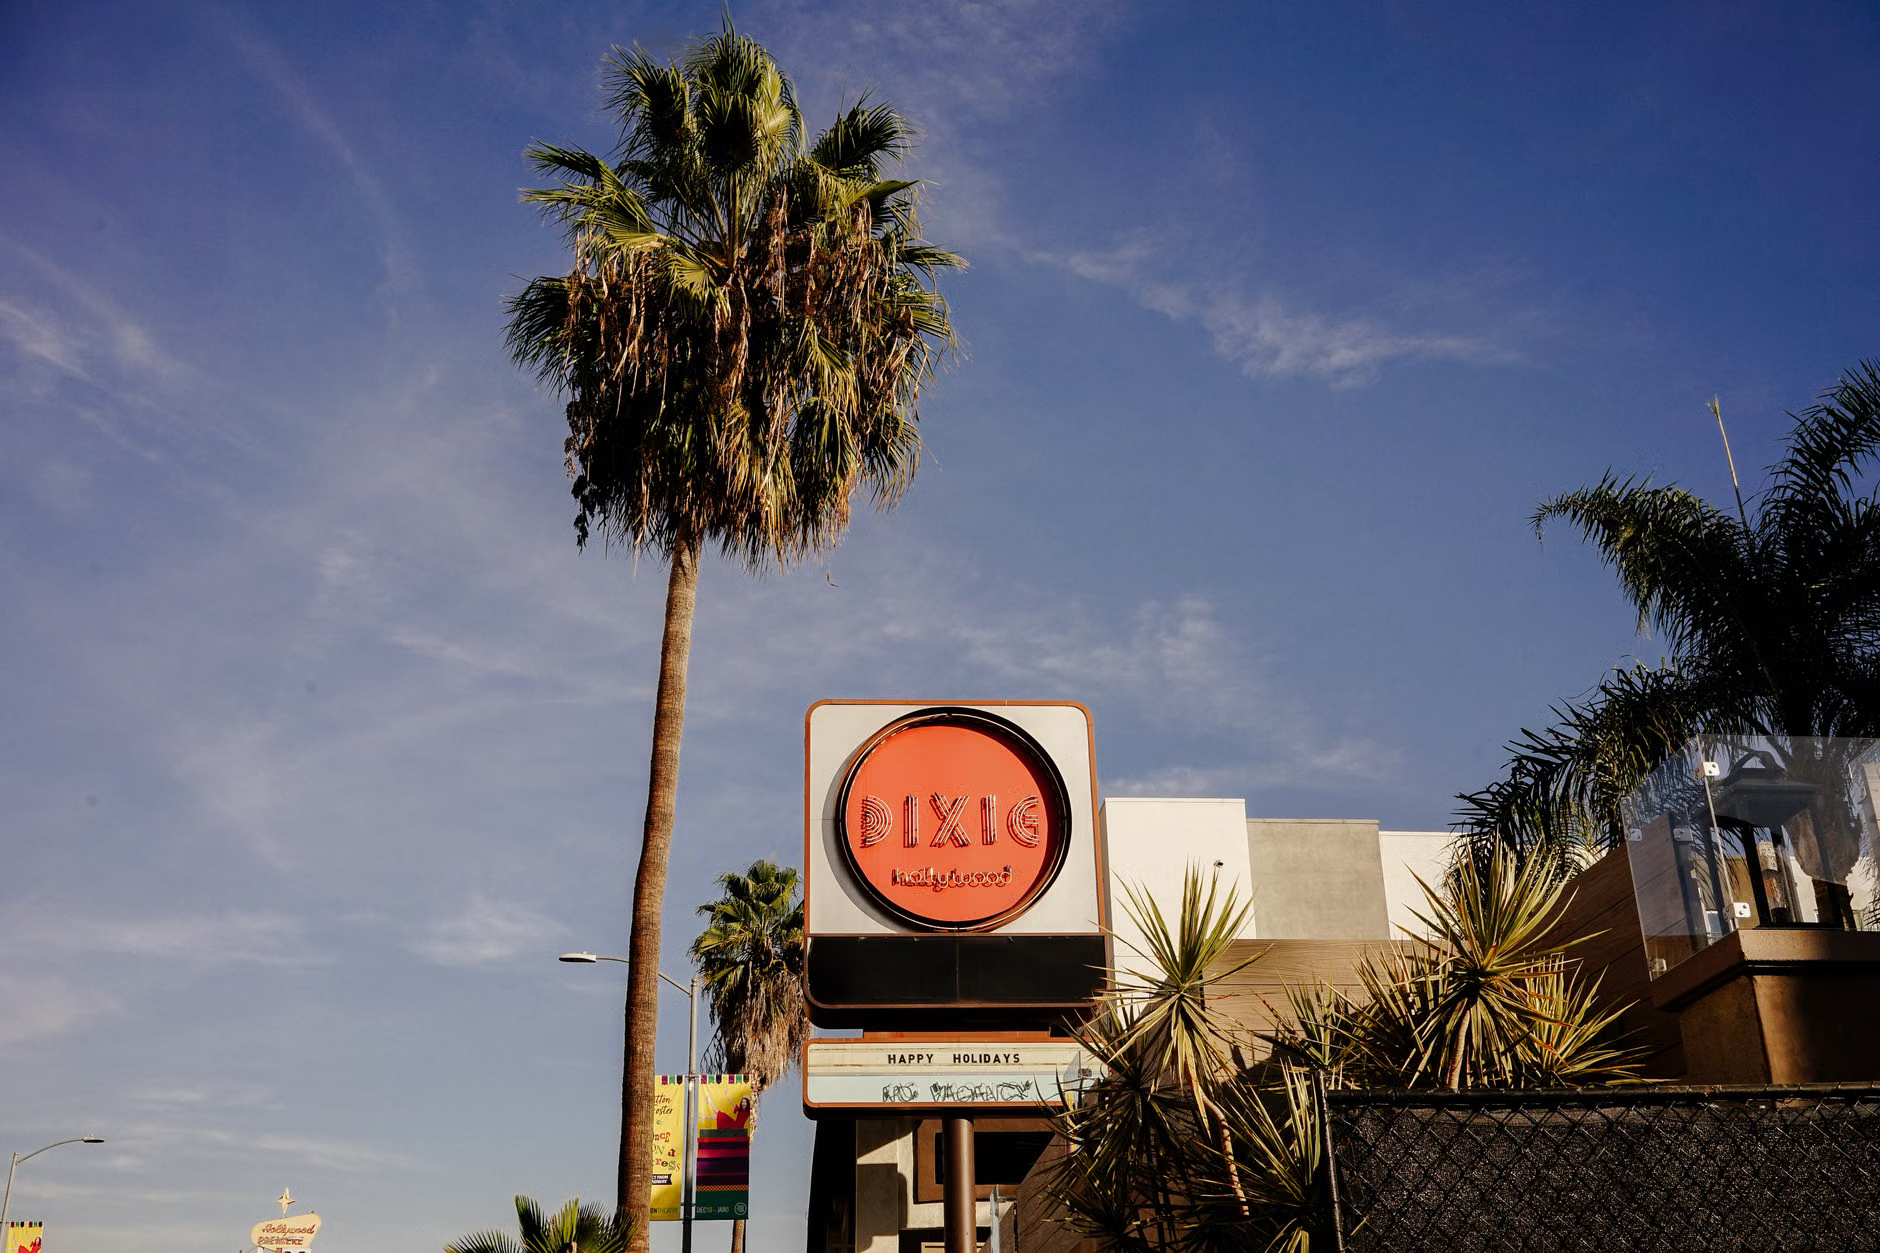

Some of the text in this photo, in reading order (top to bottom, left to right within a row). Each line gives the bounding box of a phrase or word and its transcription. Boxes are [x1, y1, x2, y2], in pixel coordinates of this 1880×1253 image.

[892, 865, 1013, 891] hollywood
[887, 1053, 1020, 1064] HAPPY HOLIDAYS
[655, 1105, 673, 1115] oster
